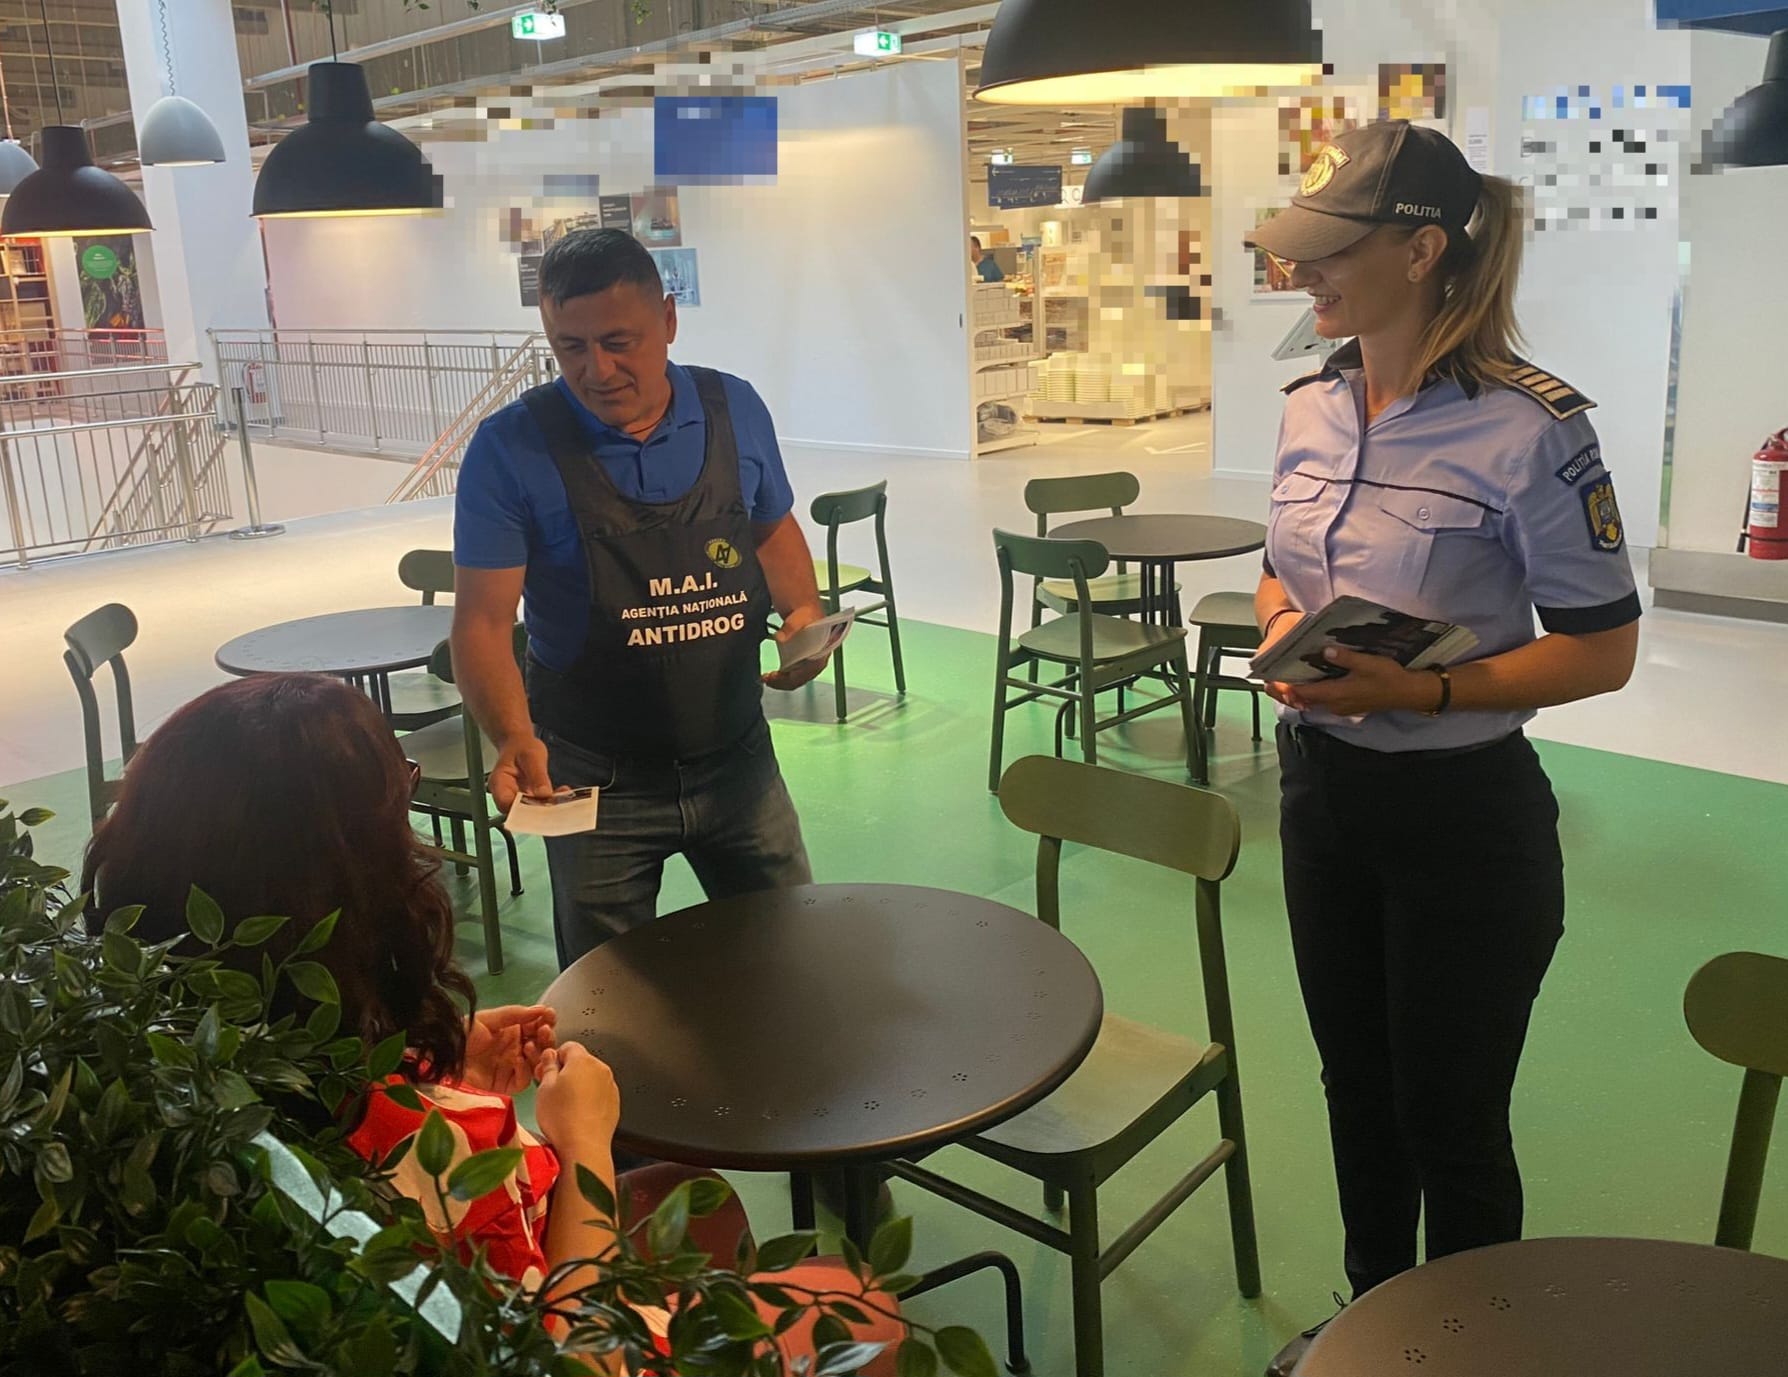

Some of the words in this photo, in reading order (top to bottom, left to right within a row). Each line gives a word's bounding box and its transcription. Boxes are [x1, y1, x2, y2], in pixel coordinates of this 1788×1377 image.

[1395, 202, 1442, 219] POLITIA
[649, 572, 718, 597] M.A.I.
[626, 613, 745, 646] ANTIDROG
